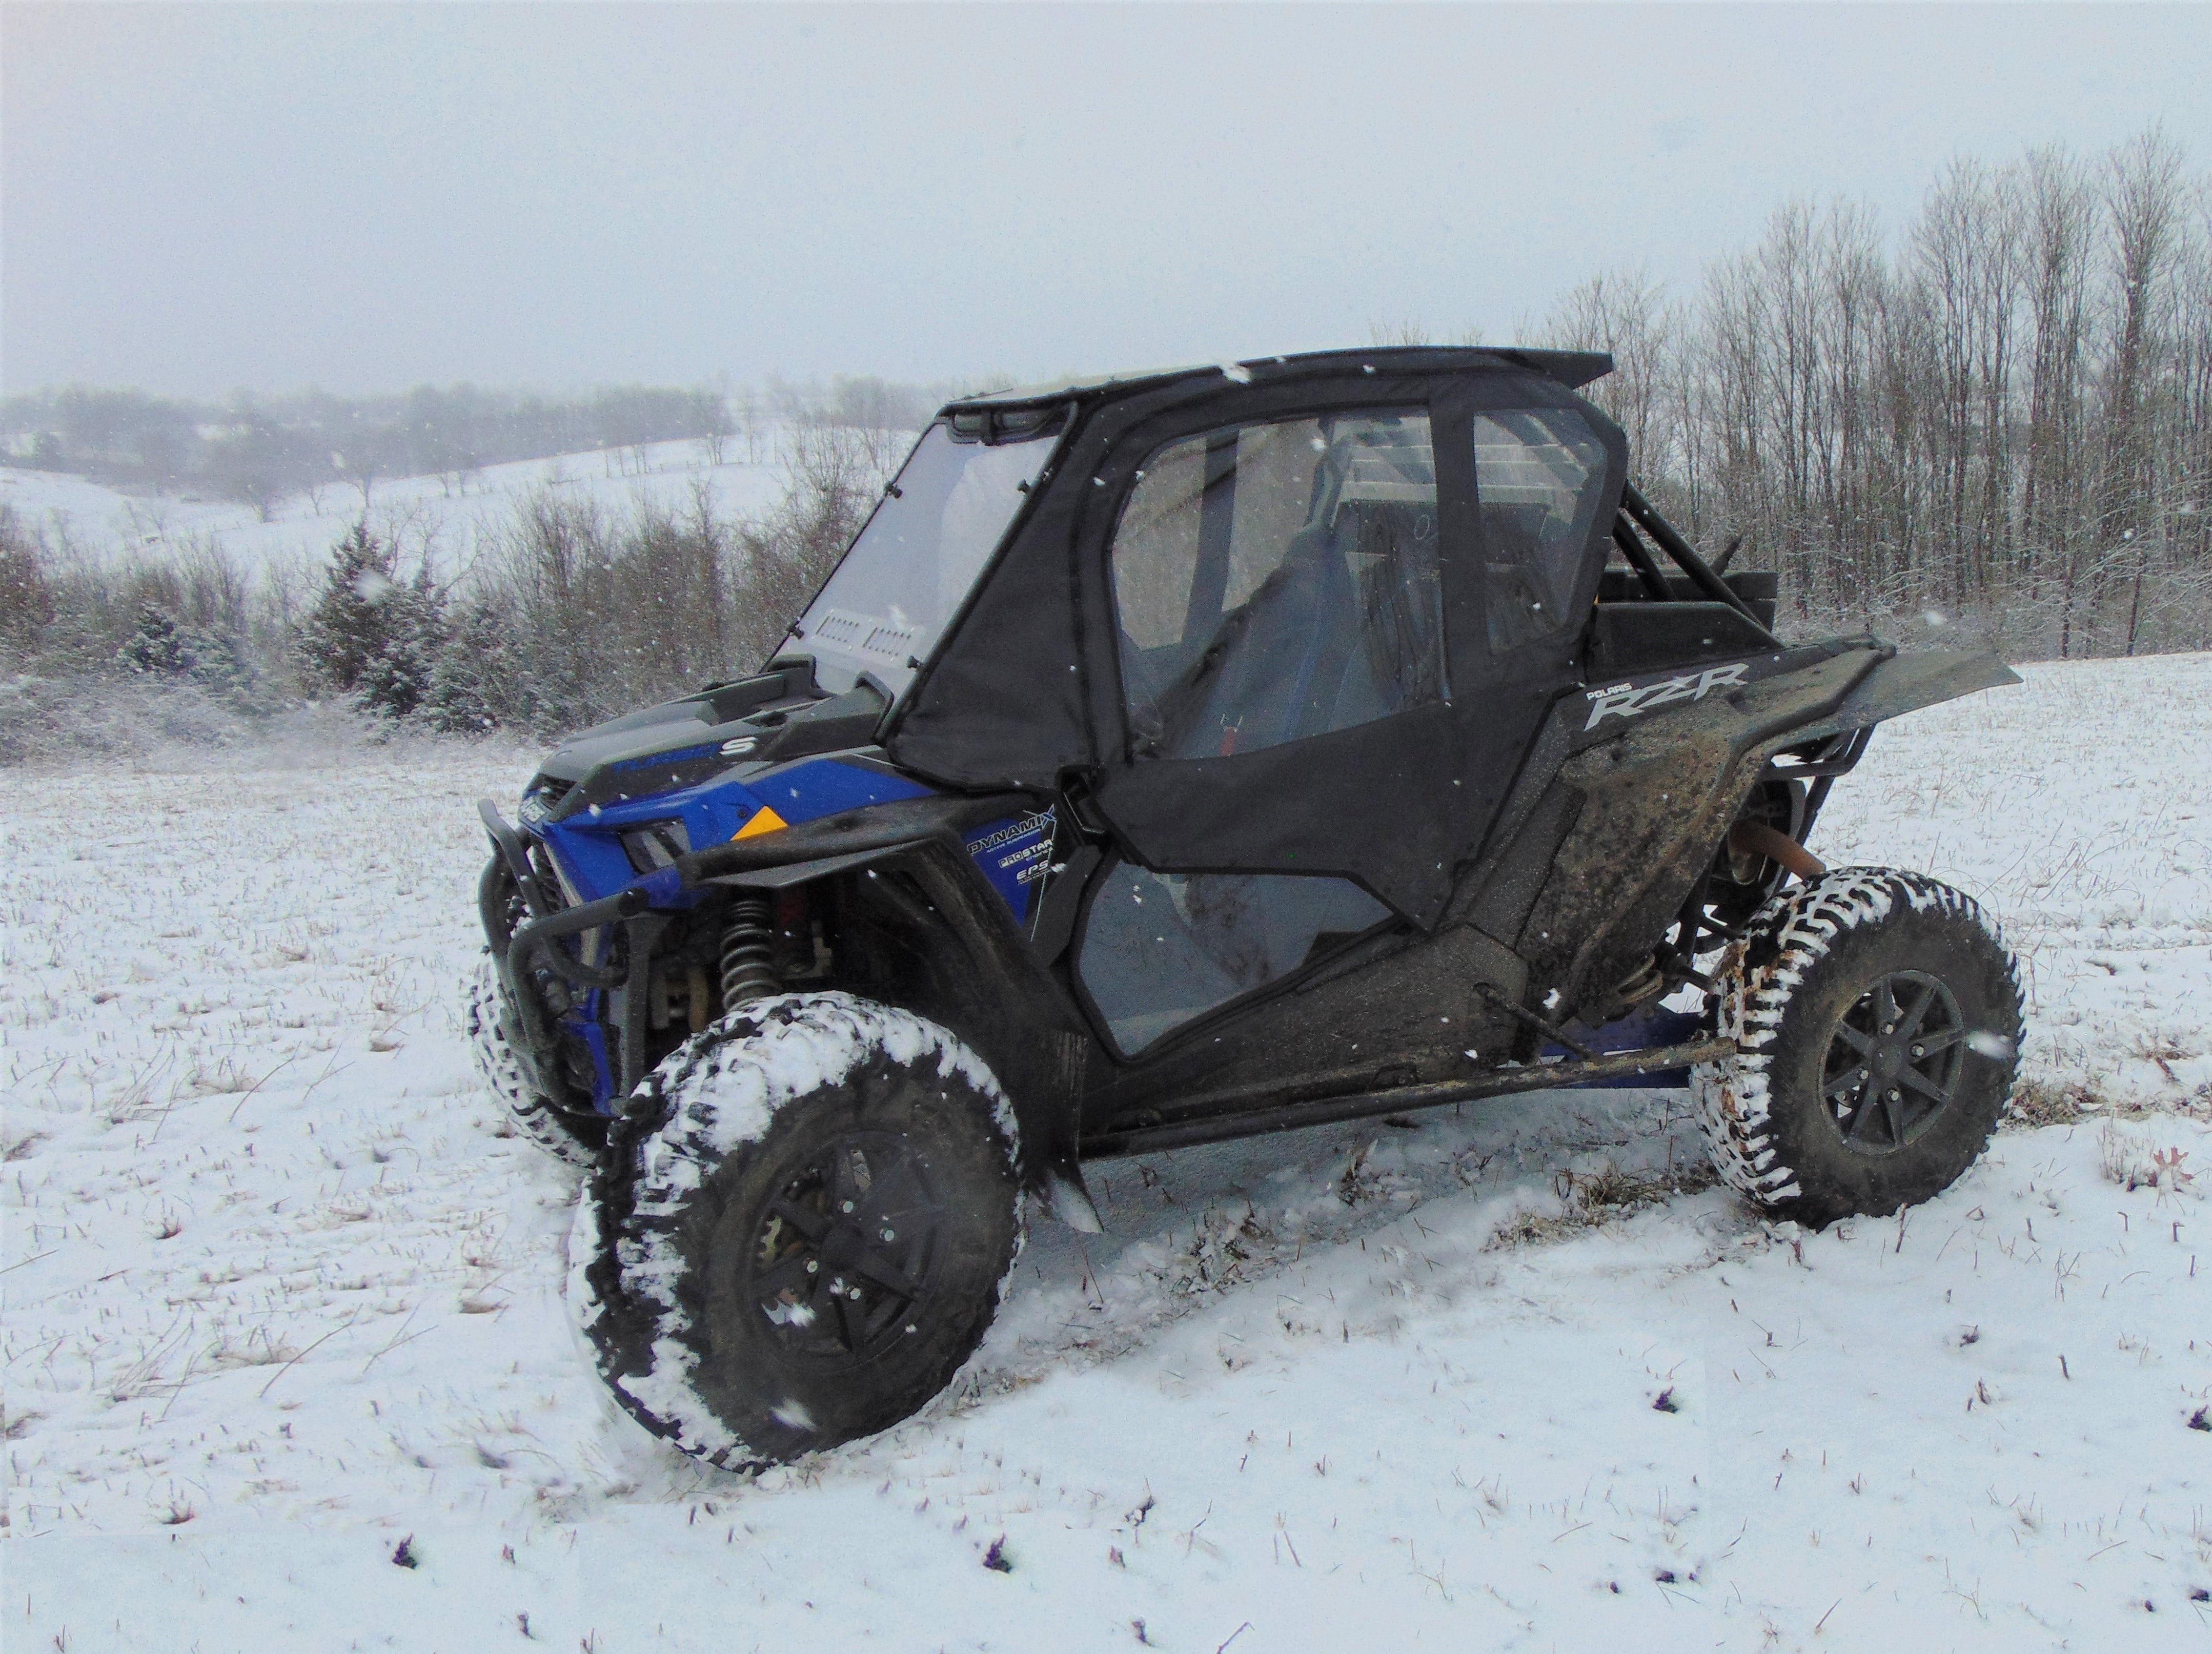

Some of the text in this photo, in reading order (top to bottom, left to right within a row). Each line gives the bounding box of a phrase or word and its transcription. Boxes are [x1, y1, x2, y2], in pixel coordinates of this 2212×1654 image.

[1584, 663, 1750, 732] RZR
[1586, 682, 1632, 701] POLARIS
[719, 737, 758, 755] S
[967, 803, 1056, 855] DYNAMIX
[998, 839, 1053, 868] PROSTAR
[1016, 860, 1049, 880] EPS
